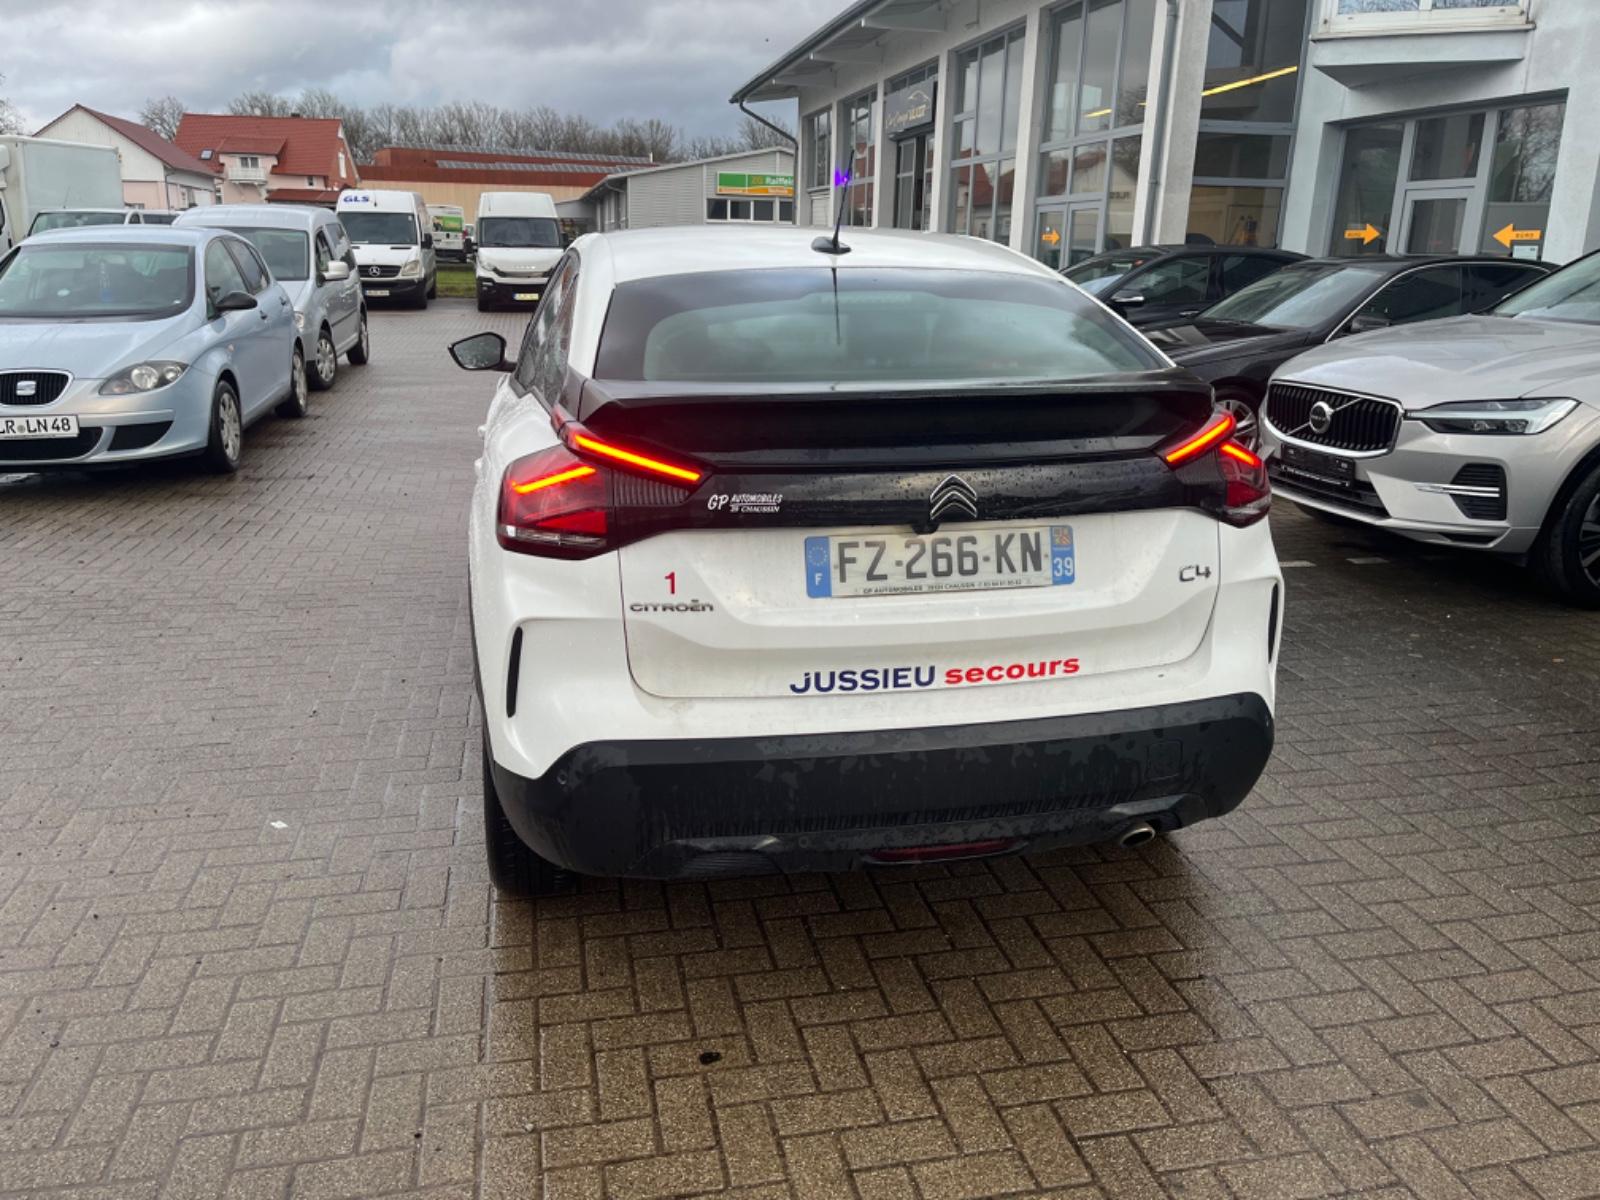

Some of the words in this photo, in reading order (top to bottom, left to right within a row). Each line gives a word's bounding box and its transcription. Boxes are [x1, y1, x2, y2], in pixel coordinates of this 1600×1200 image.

[343, 195, 369, 203] GLS
[26, 418, 48, 433] LN
[51, 417, 71, 432] 48
[707, 494, 729, 511] GP
[730, 493, 783, 504] AUTOMOBILES
[1053, 557, 1074, 577] 39
[1179, 565, 1212, 582] C4
[664, 571, 676, 595] 1
[814, 573, 823, 586] F
[944, 657, 1081, 685] secours
